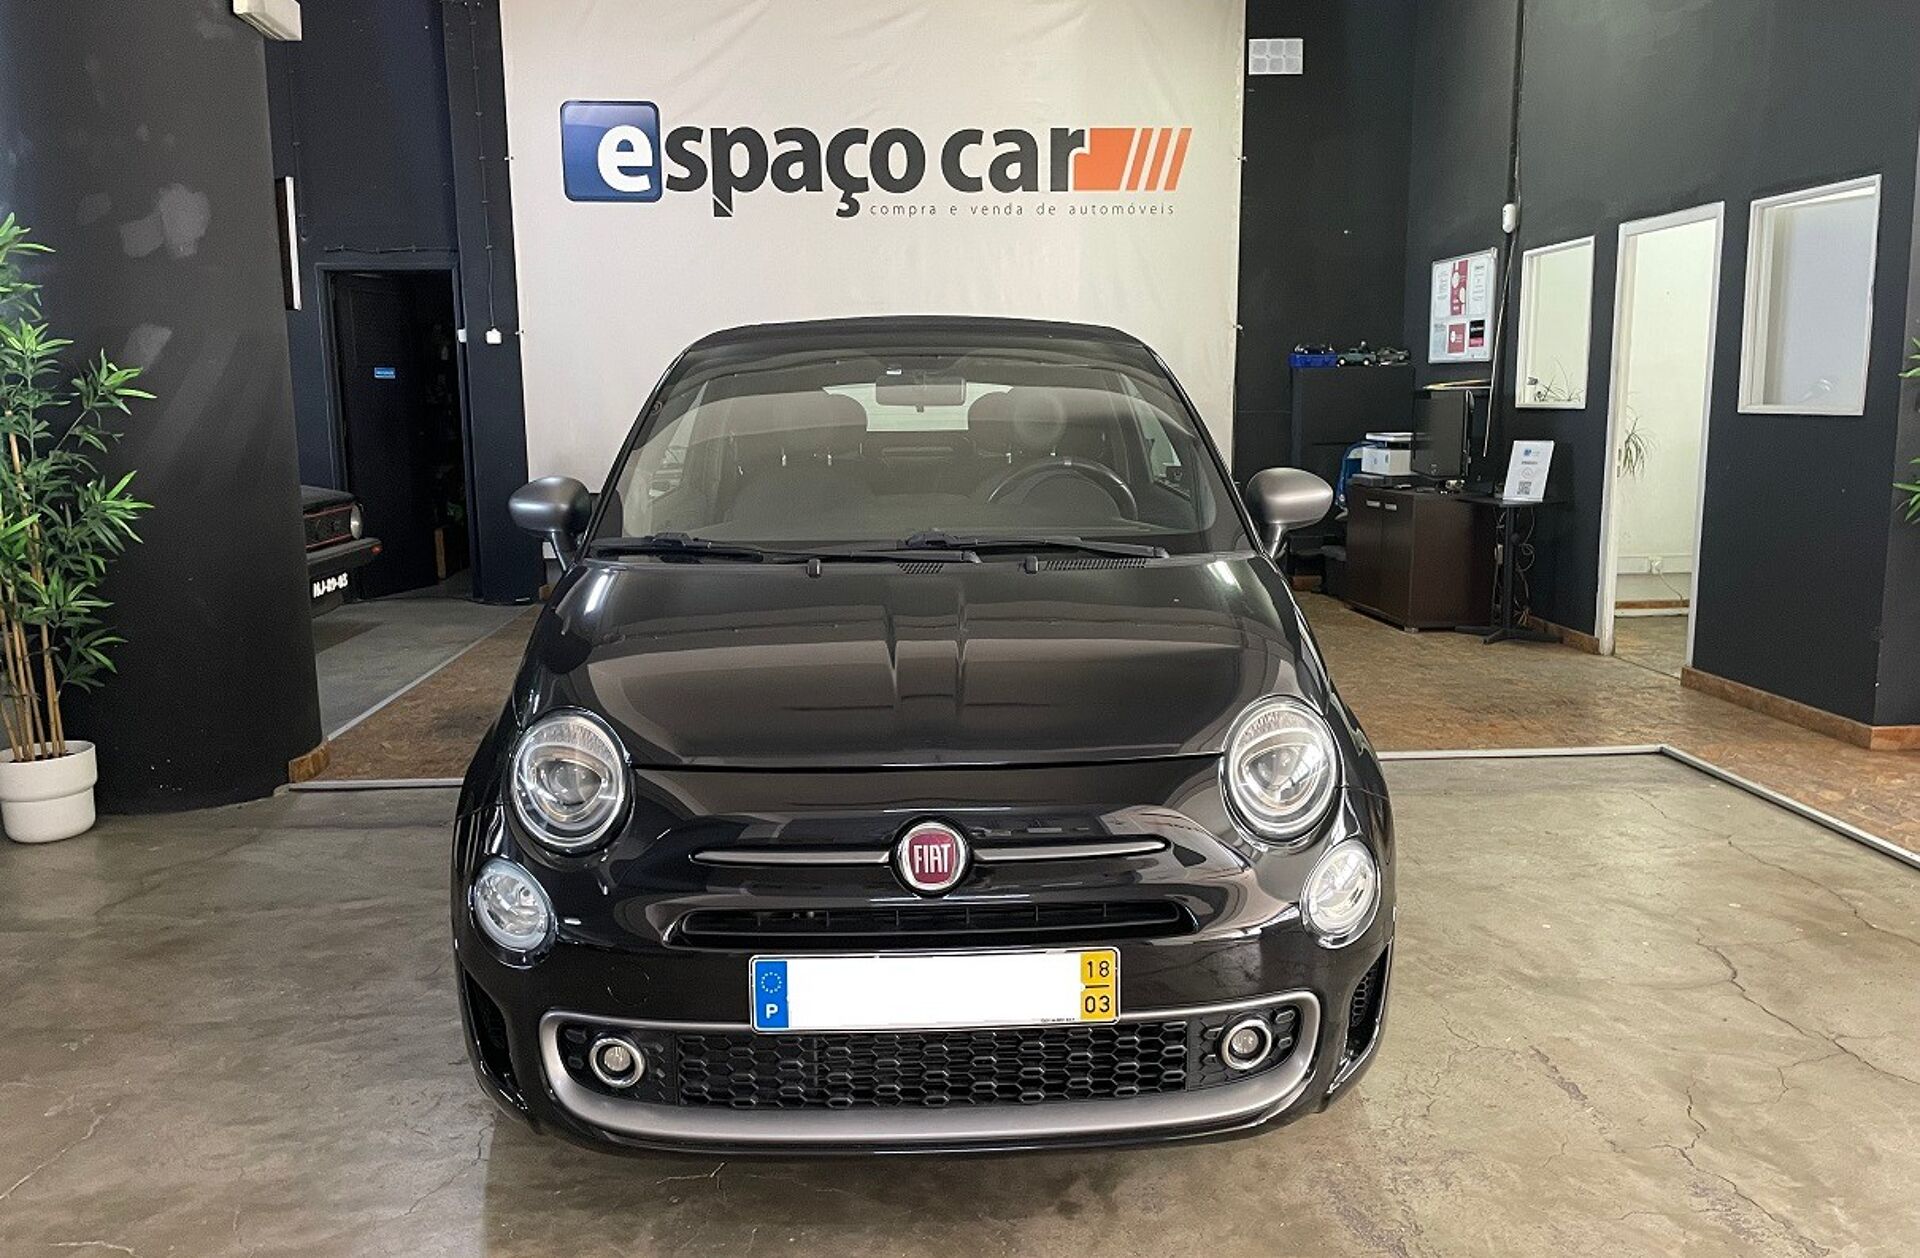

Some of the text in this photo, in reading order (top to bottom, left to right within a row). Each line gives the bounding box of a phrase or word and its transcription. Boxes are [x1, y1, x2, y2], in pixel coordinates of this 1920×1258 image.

[598, 126, 1085, 218] espaço car
[869, 203, 1174, 217] compra e venda de automóveis
[913, 843, 952, 874] FIAT
[1086, 960, 1110, 978] 18
[766, 1003, 778, 1019] P
[1085, 995, 1111, 1014] 03
